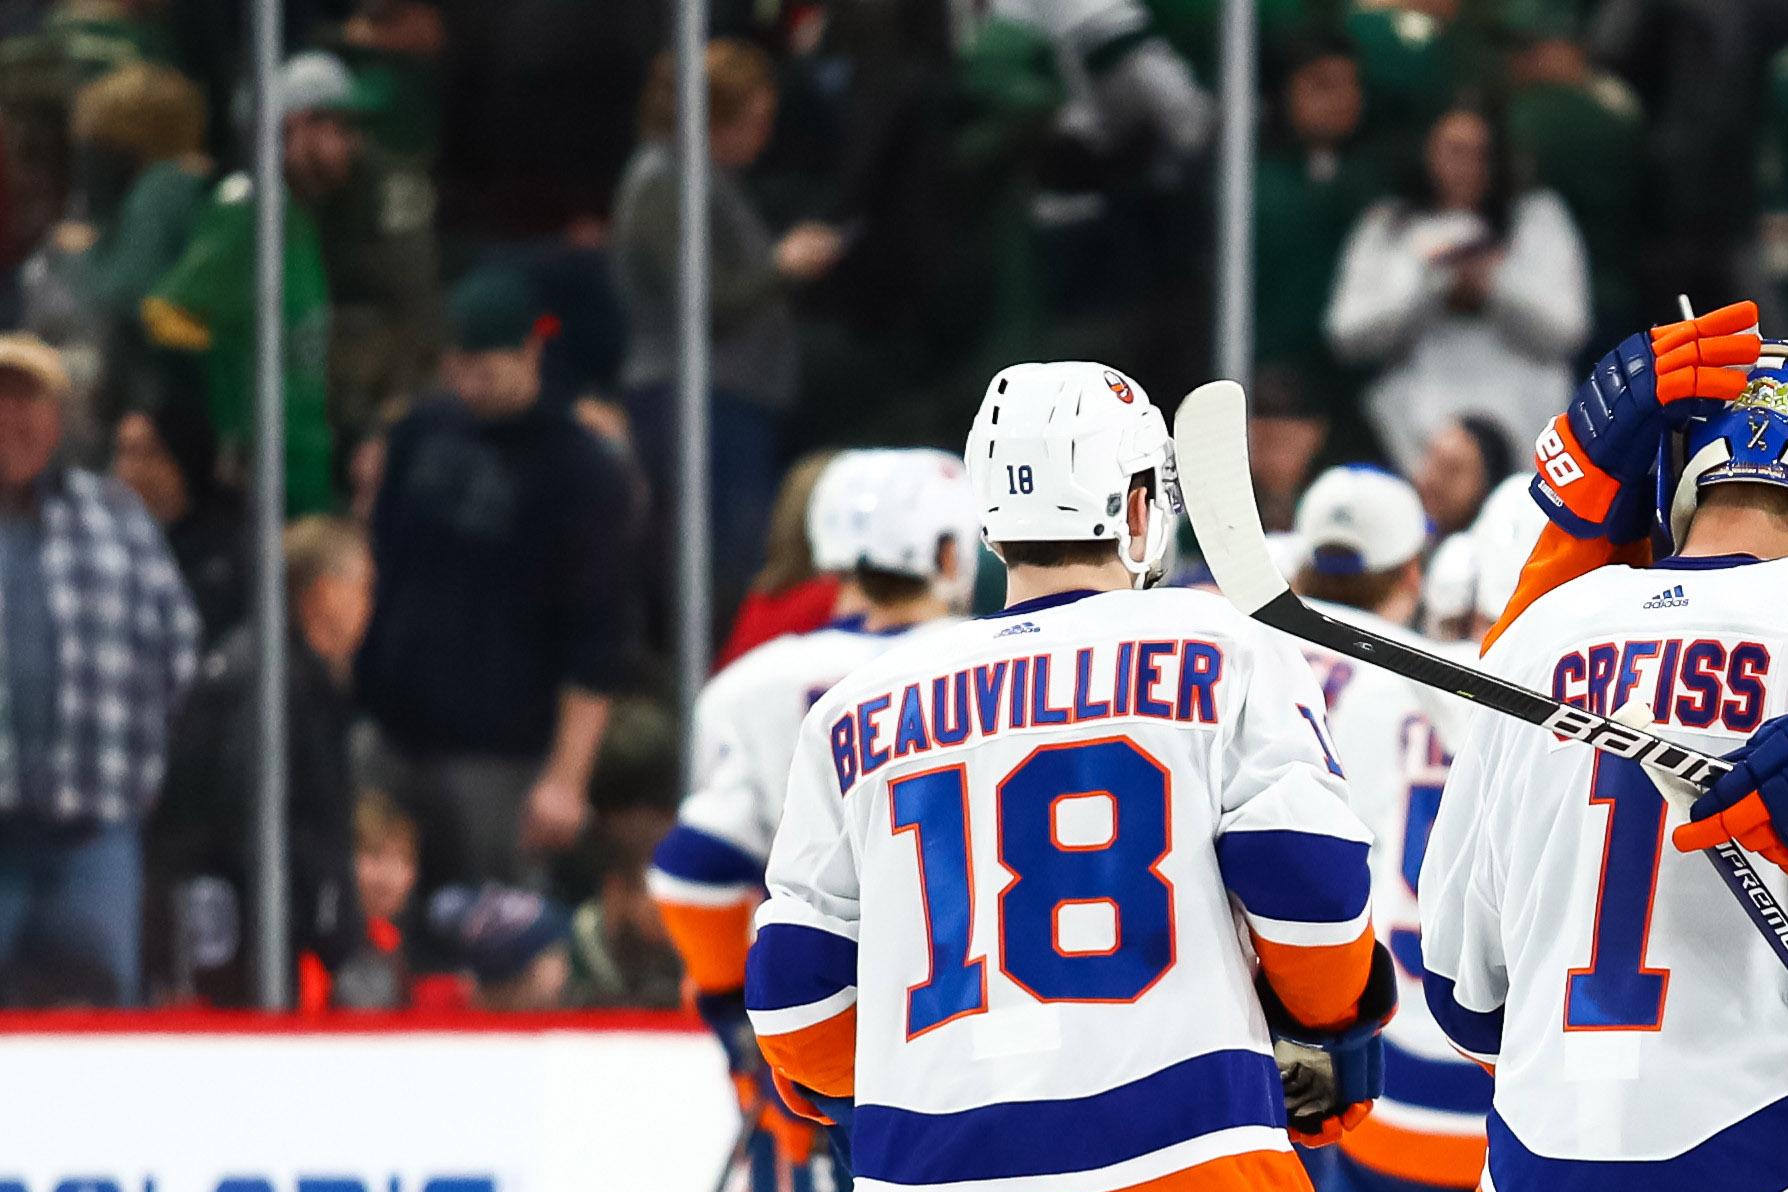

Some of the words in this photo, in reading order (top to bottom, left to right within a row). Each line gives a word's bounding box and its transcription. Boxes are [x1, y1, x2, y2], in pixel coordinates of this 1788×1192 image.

[1006, 465, 1034, 495] 18
[830, 640, 1224, 799] BEAUVILLIER
[888, 734, 1177, 1043] 18
[1562, 745, 1672, 1033] 1
